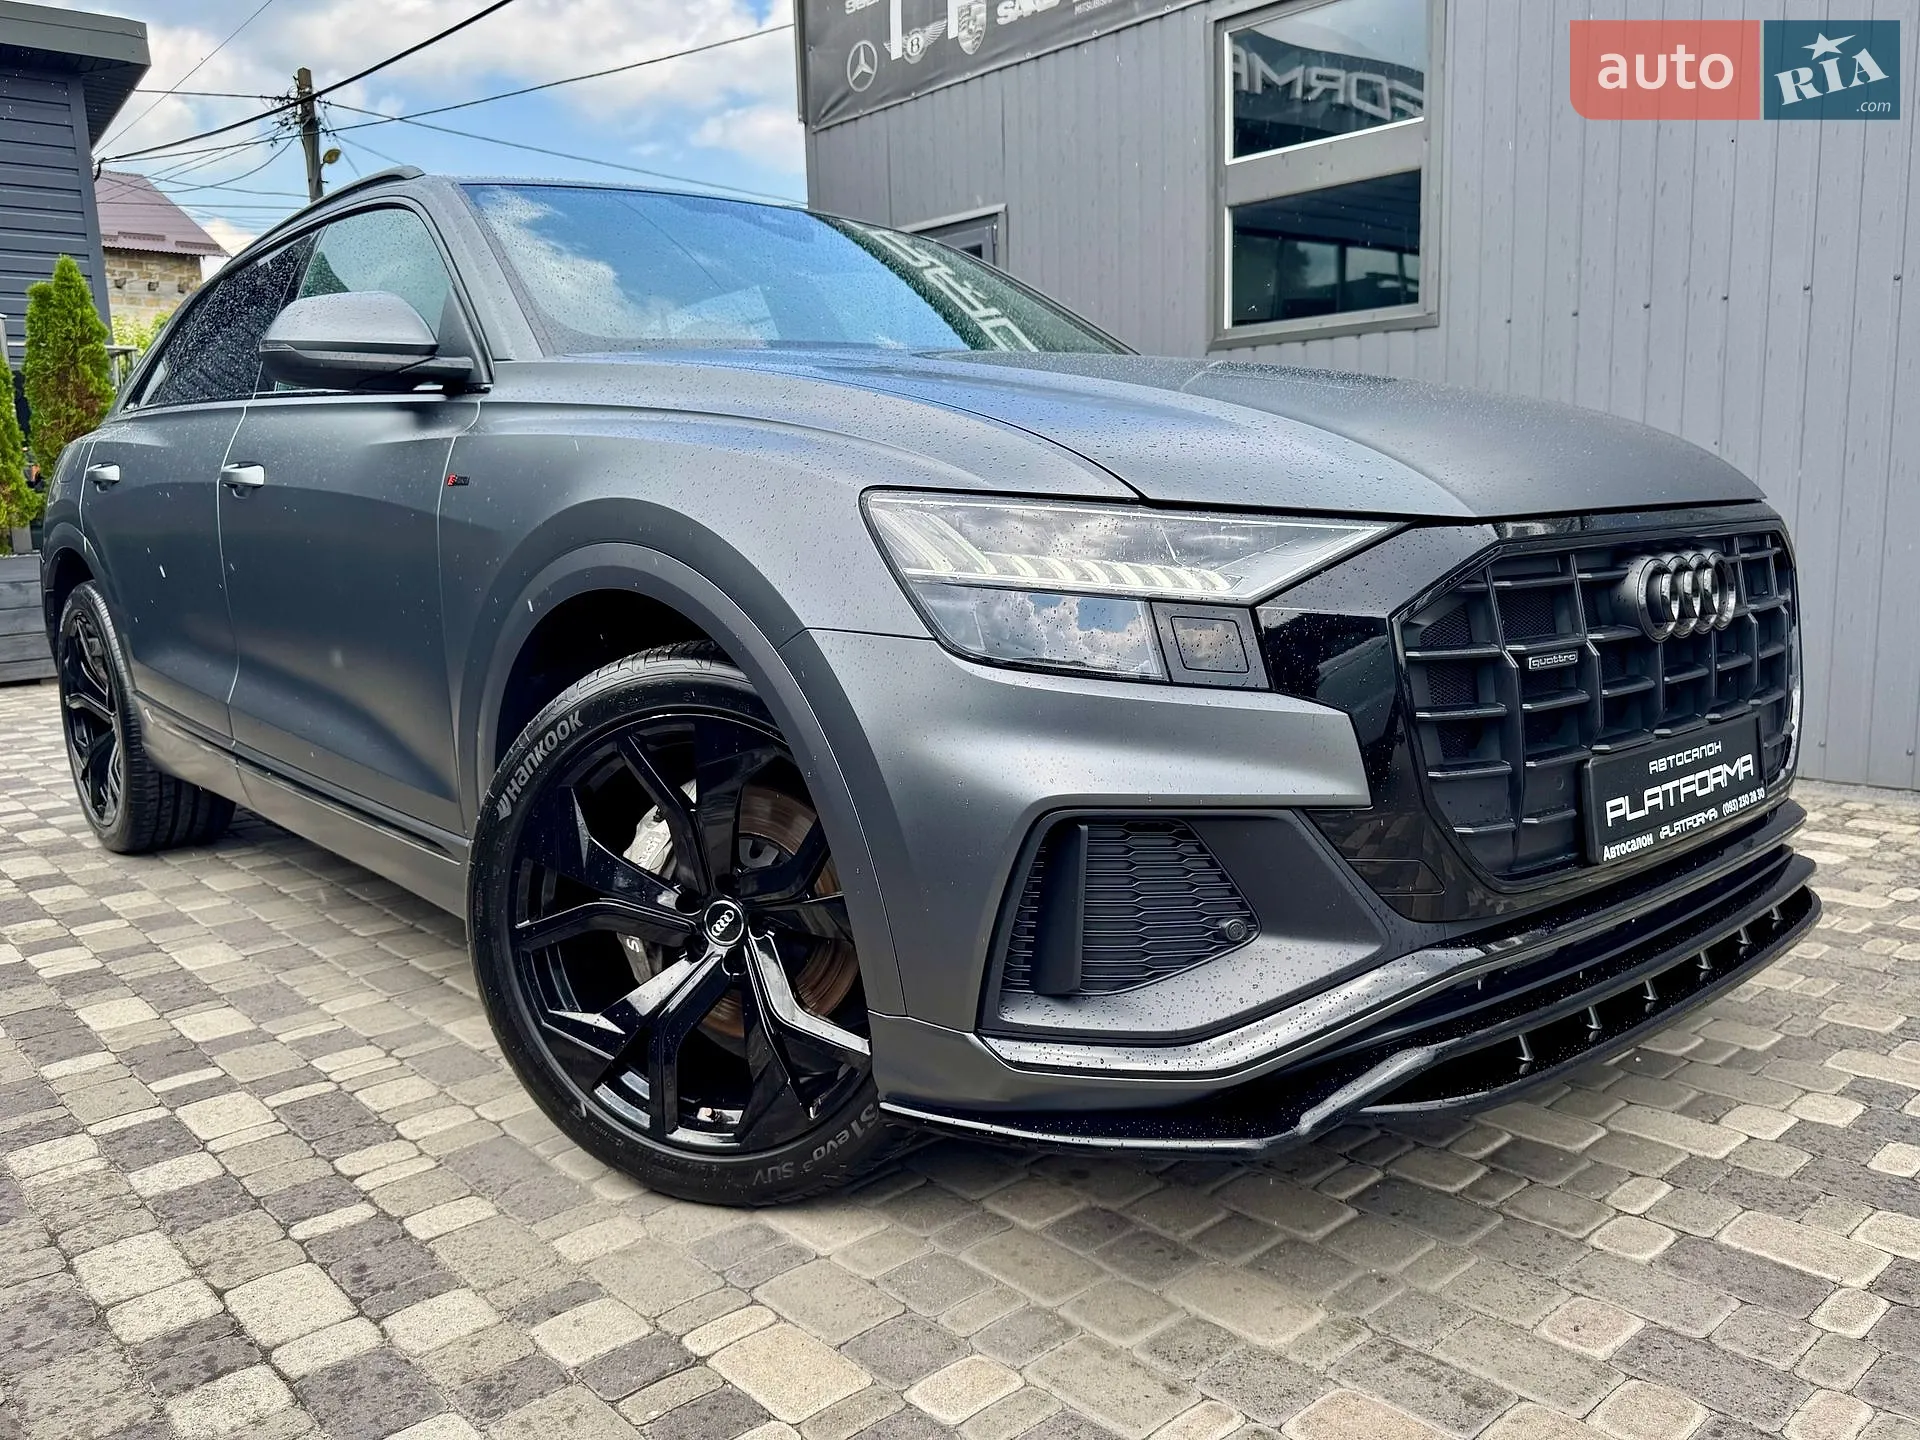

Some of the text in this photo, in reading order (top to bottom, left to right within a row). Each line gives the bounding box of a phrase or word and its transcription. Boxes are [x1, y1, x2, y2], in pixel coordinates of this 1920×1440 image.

[1531, 654, 1576, 668] quattro
[1605, 753, 1754, 827] PLATFORMA
[1603, 833, 1654, 862] Автосалон
[752, 1161, 795, 1186] SUV
